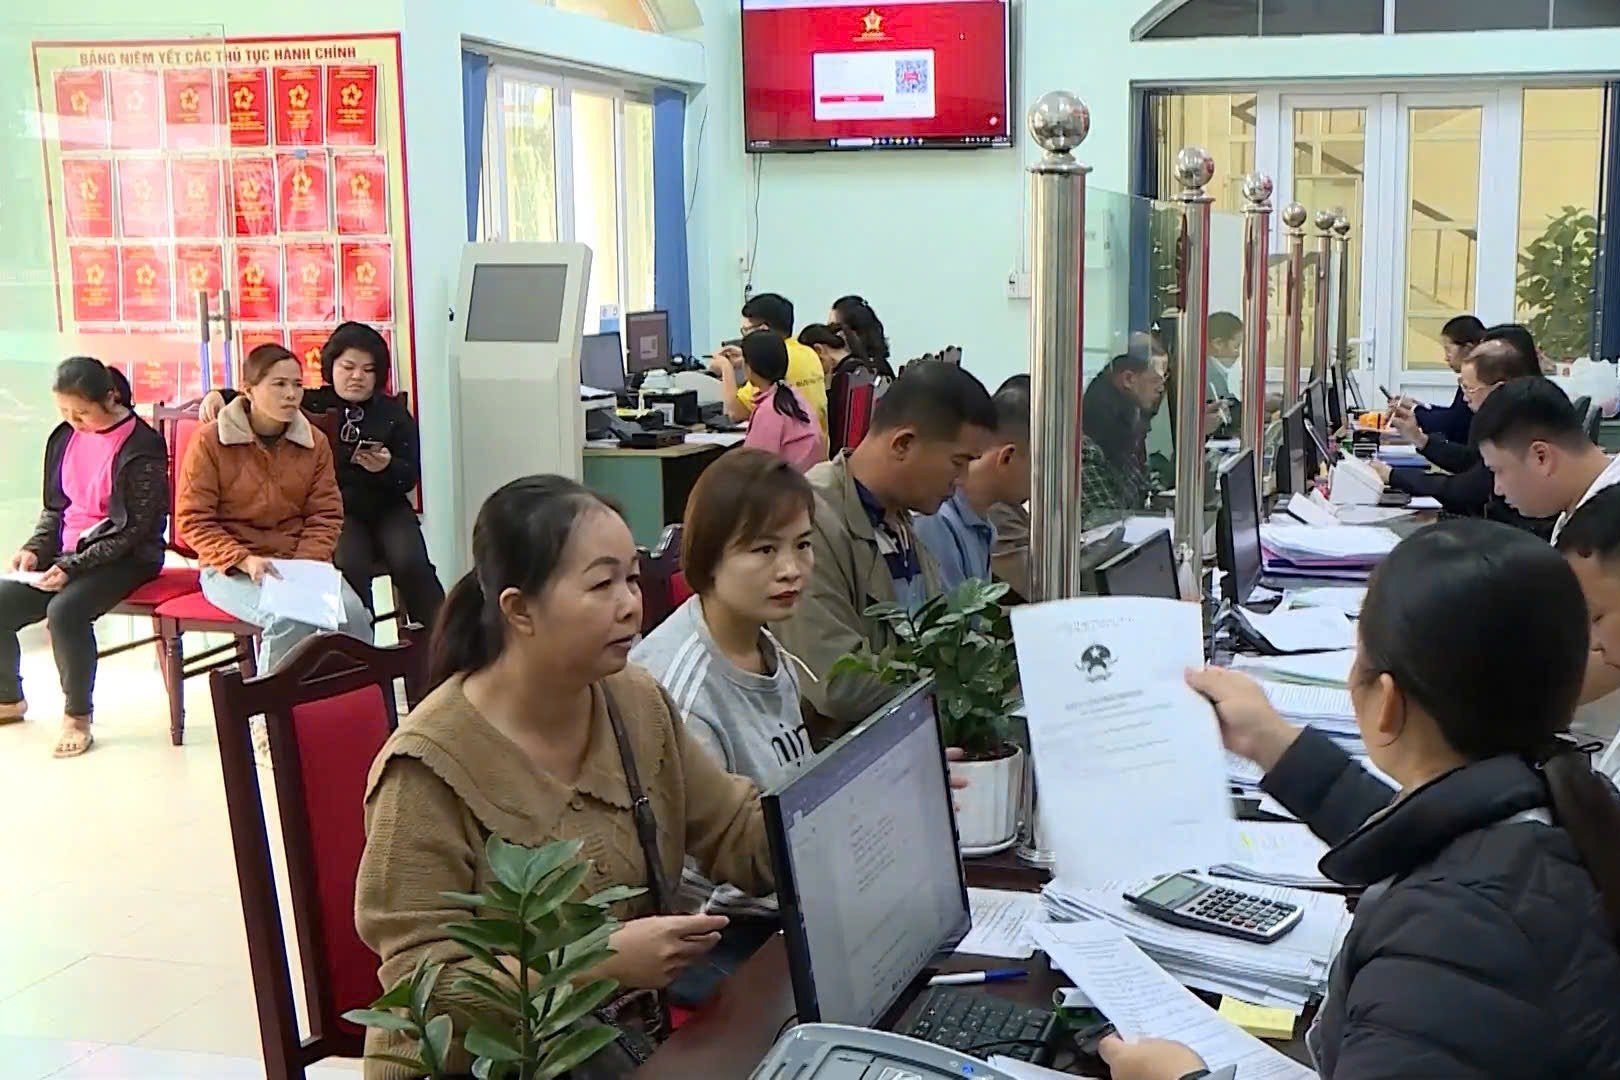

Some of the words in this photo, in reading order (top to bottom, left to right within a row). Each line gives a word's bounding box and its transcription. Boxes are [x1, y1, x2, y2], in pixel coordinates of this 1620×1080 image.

[79, 50, 117, 65] BẢNG
[158, 48, 181, 64] YẾT
[185, 48, 212, 64] CÁC
[216, 46, 242, 62] THỦ
[246, 49, 270, 64] TỤC
[274, 46, 311, 60] HÀNH
[315, 44, 356, 59] CHÍNH
